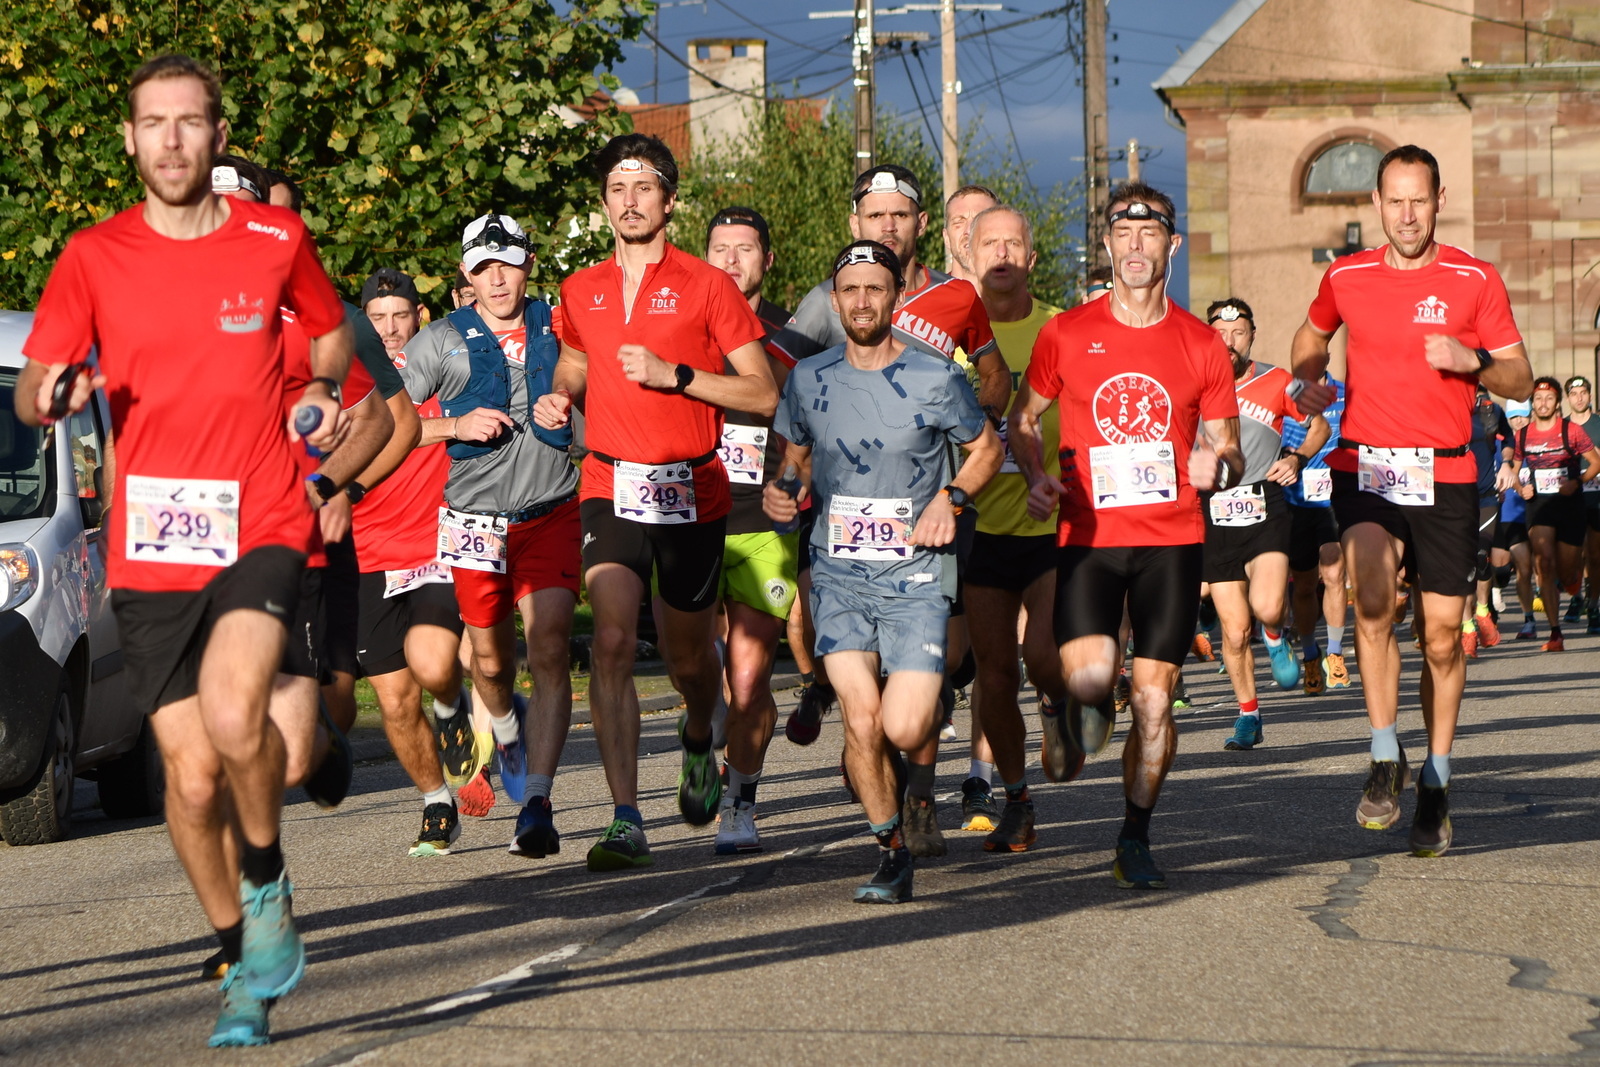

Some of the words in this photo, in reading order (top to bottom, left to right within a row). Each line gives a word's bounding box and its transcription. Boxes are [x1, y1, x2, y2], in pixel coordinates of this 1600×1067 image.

[247, 221, 282, 236] CRAFT
[651, 298, 677, 308] TDLR
[1417, 307, 1445, 319] TDLR
[896, 310, 956, 357] KUHN
[1098, 375, 1168, 409] LIBERTE
[1118, 393, 1129, 427] CAP
[1386, 469, 1409, 487] 94
[639, 485, 678, 506] 249
[1226, 501, 1254, 515] 190
[158, 511, 211, 539] 239
[852, 520, 894, 542] 219
[461, 534, 485, 553] 26
